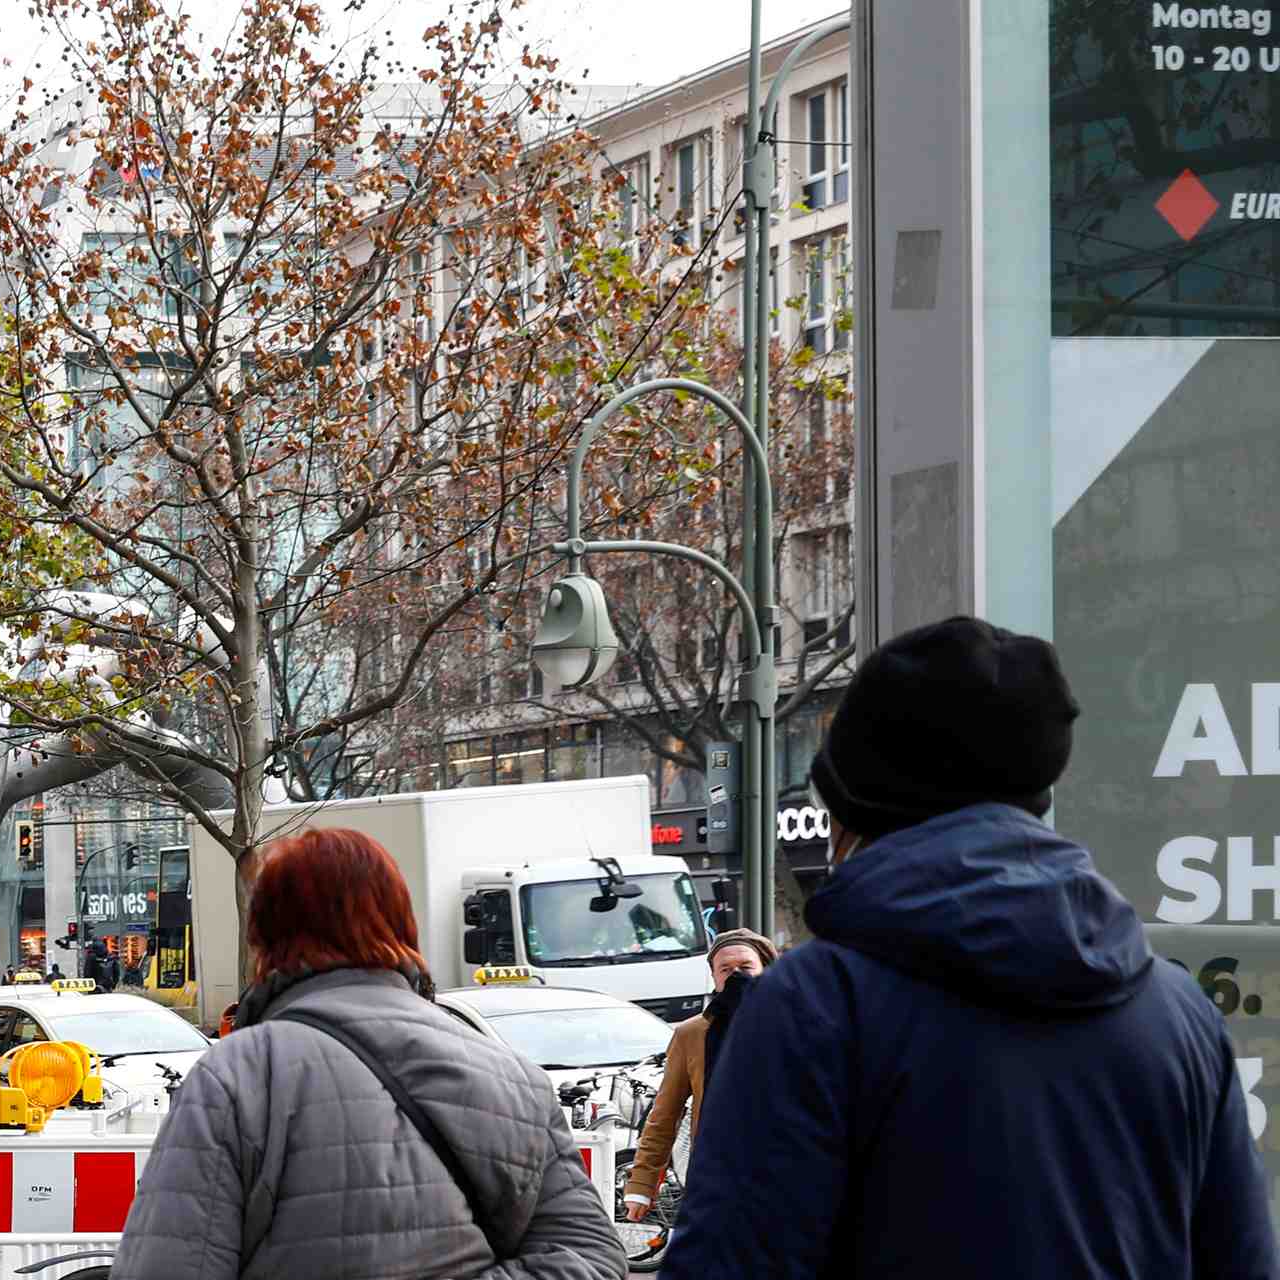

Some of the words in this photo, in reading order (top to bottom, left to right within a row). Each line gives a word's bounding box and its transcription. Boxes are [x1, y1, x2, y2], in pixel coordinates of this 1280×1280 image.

[1152, 2, 1272, 36] Montag
[1151, 45, 1185, 71] 10
[1212, 46, 1251, 72] 20
[490, 968, 525, 978] TAXI
